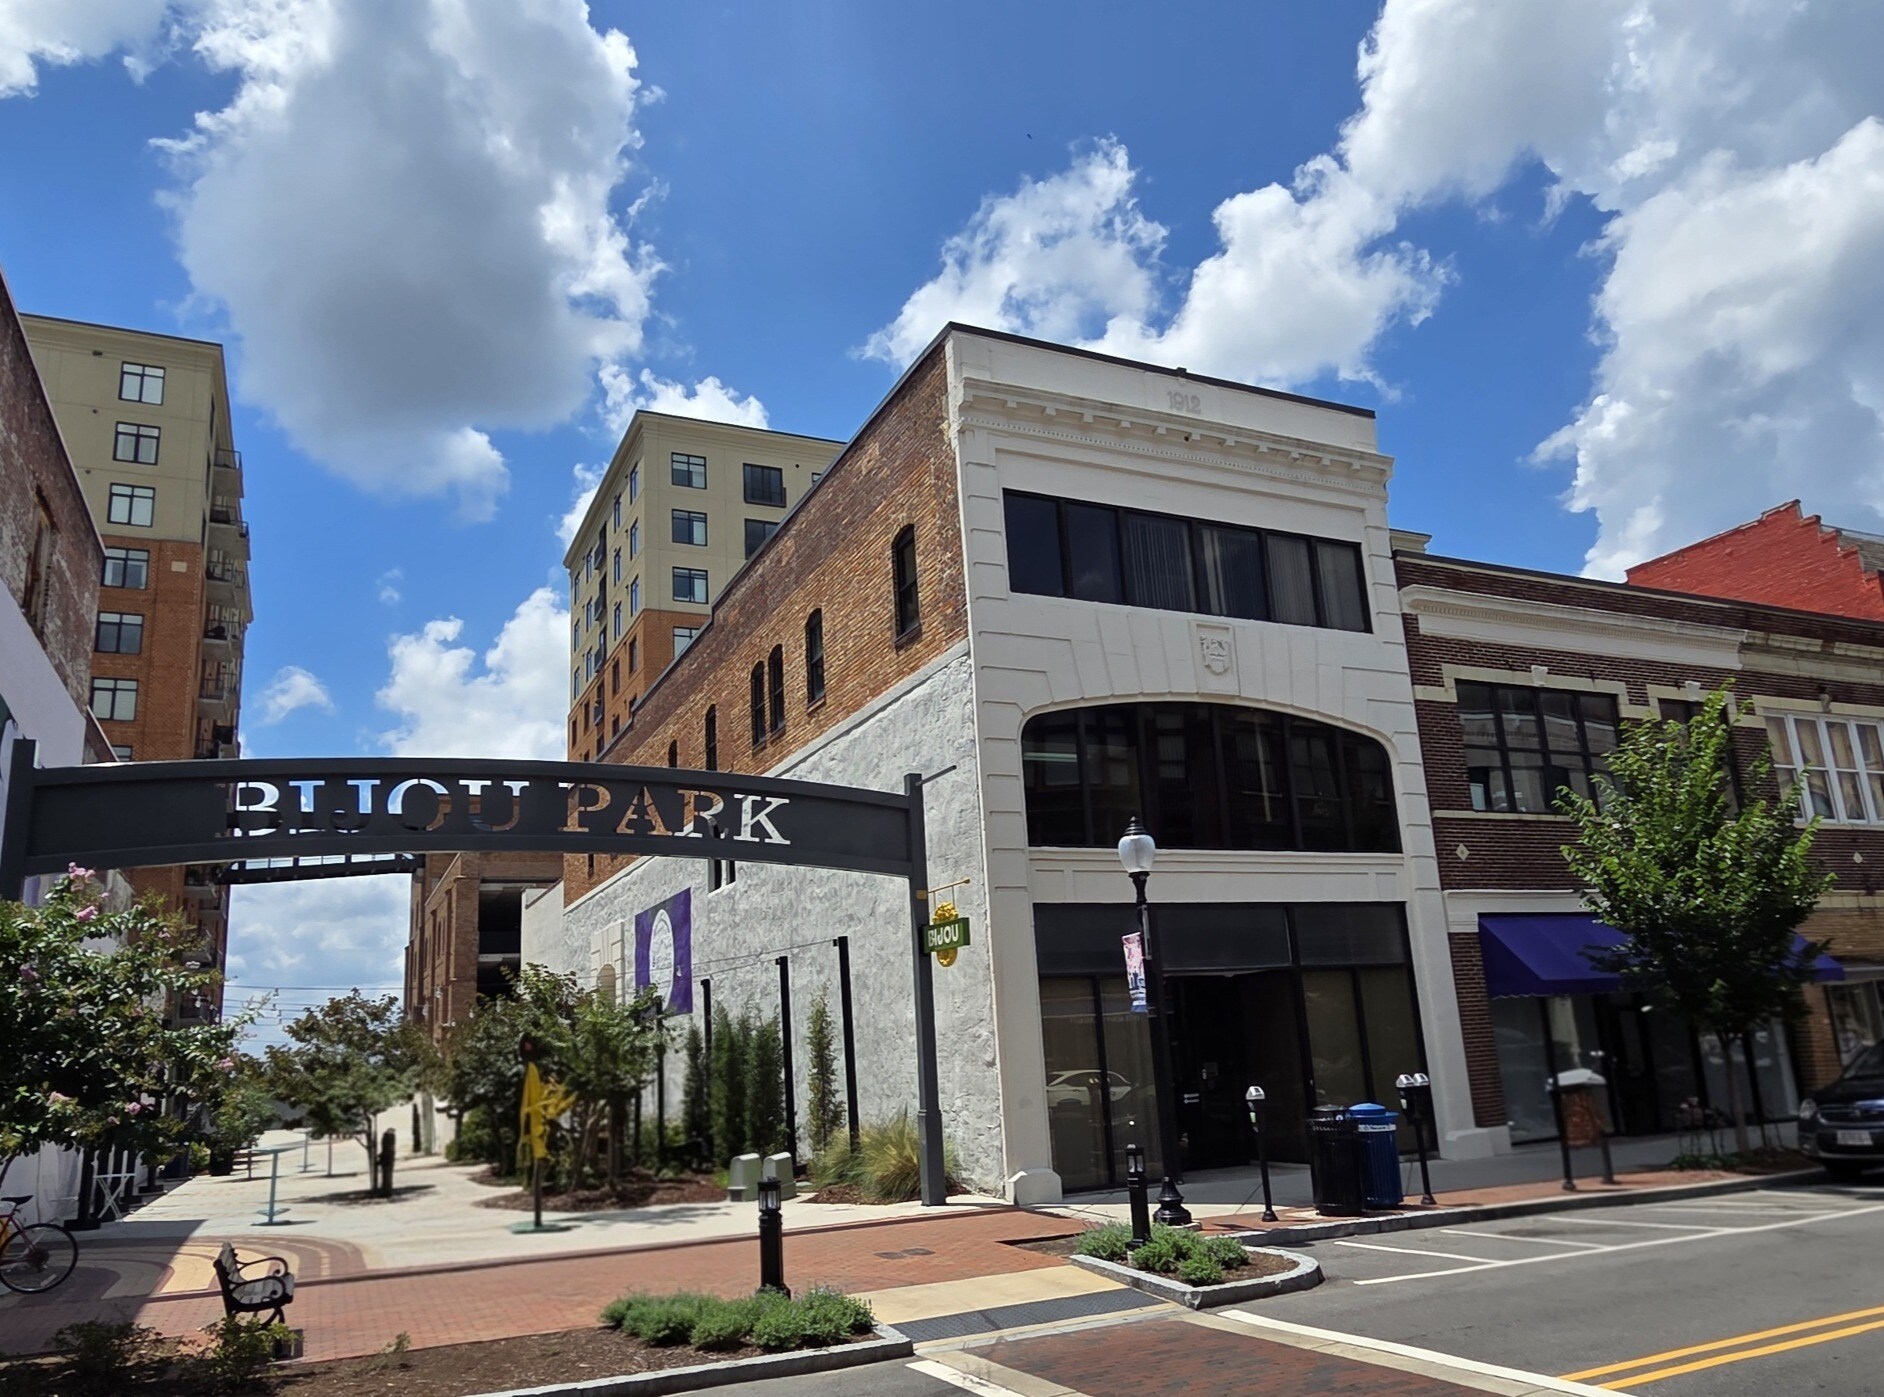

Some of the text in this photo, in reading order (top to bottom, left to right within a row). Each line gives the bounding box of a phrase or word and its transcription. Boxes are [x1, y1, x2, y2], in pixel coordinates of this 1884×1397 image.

[1167, 391, 1201, 414] 1912
[214, 778, 790, 845] BIJOU PARK
[928, 924, 959, 947] BIJOU
